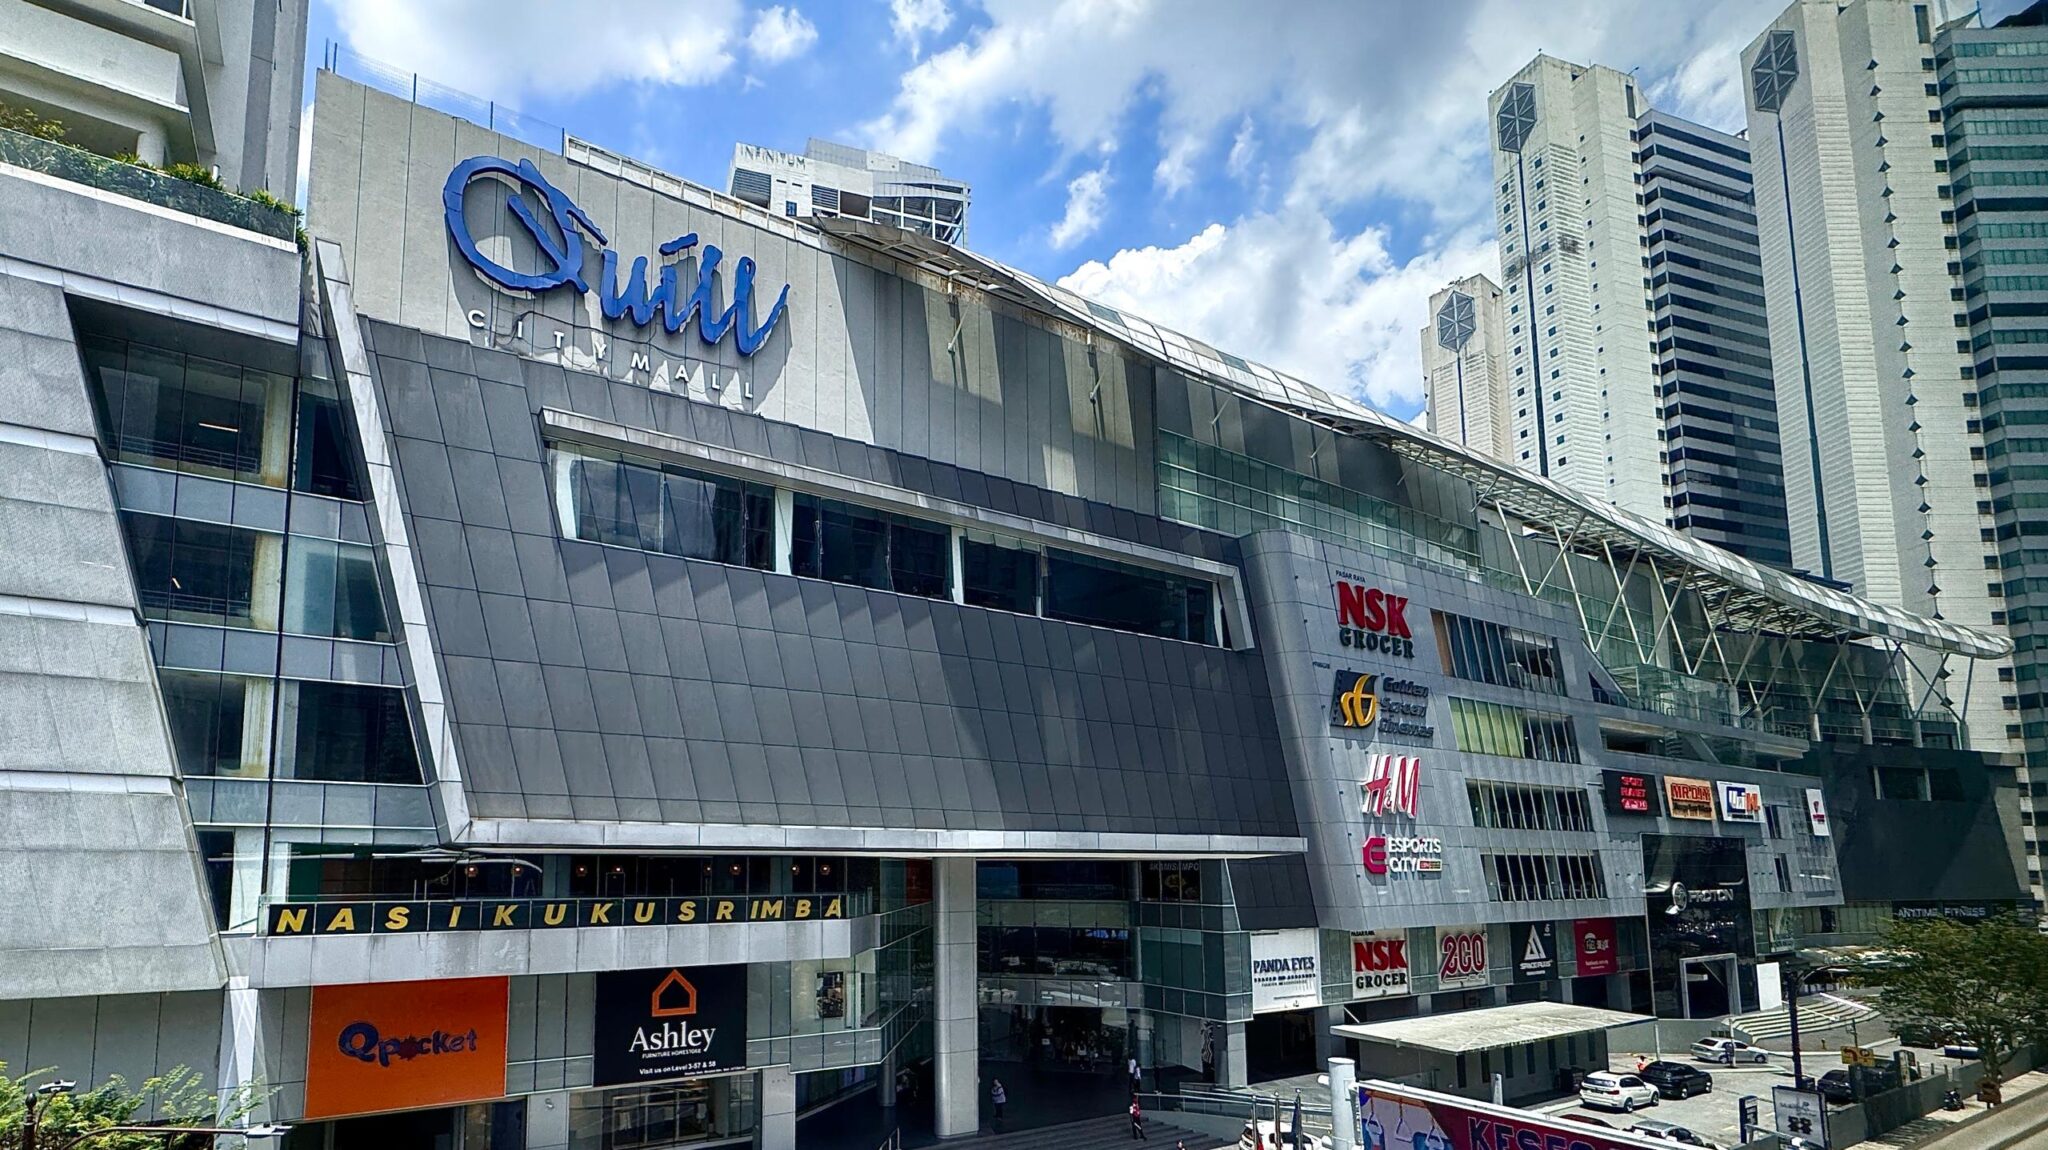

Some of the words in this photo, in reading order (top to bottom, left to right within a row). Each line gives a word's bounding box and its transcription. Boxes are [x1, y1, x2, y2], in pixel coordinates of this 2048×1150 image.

[740, 145, 806, 170] INFINITUM
[443, 156, 790, 357] Quill
[468, 308, 606, 360] CITY
[630, 352, 754, 399] MALL
[1336, 580, 1412, 639] NSK
[1340, 627, 1415, 659] GROCER
[1357, 753, 1420, 819] H&M
[1388, 837, 1441, 853] ESPORTS
[1389, 857, 1418, 872] CITY
[1688, 889, 1734, 902] PROTON
[275, 905, 461, 933] NASI
[492, 900, 697, 927] KUKUS
[714, 898, 842, 920] RIMBA
[1253, 958, 1291, 974] PANDA
[1291, 956, 1315, 971] EYES
[1354, 939, 1408, 972] NSK
[1356, 972, 1407, 989] GROCER
[628, 1020, 716, 1052] Ashley
[641, 1050, 671, 1059] FURNITURE
[639, 1066, 654, 1075] Visit
[671, 1064, 687, 1072] Level
